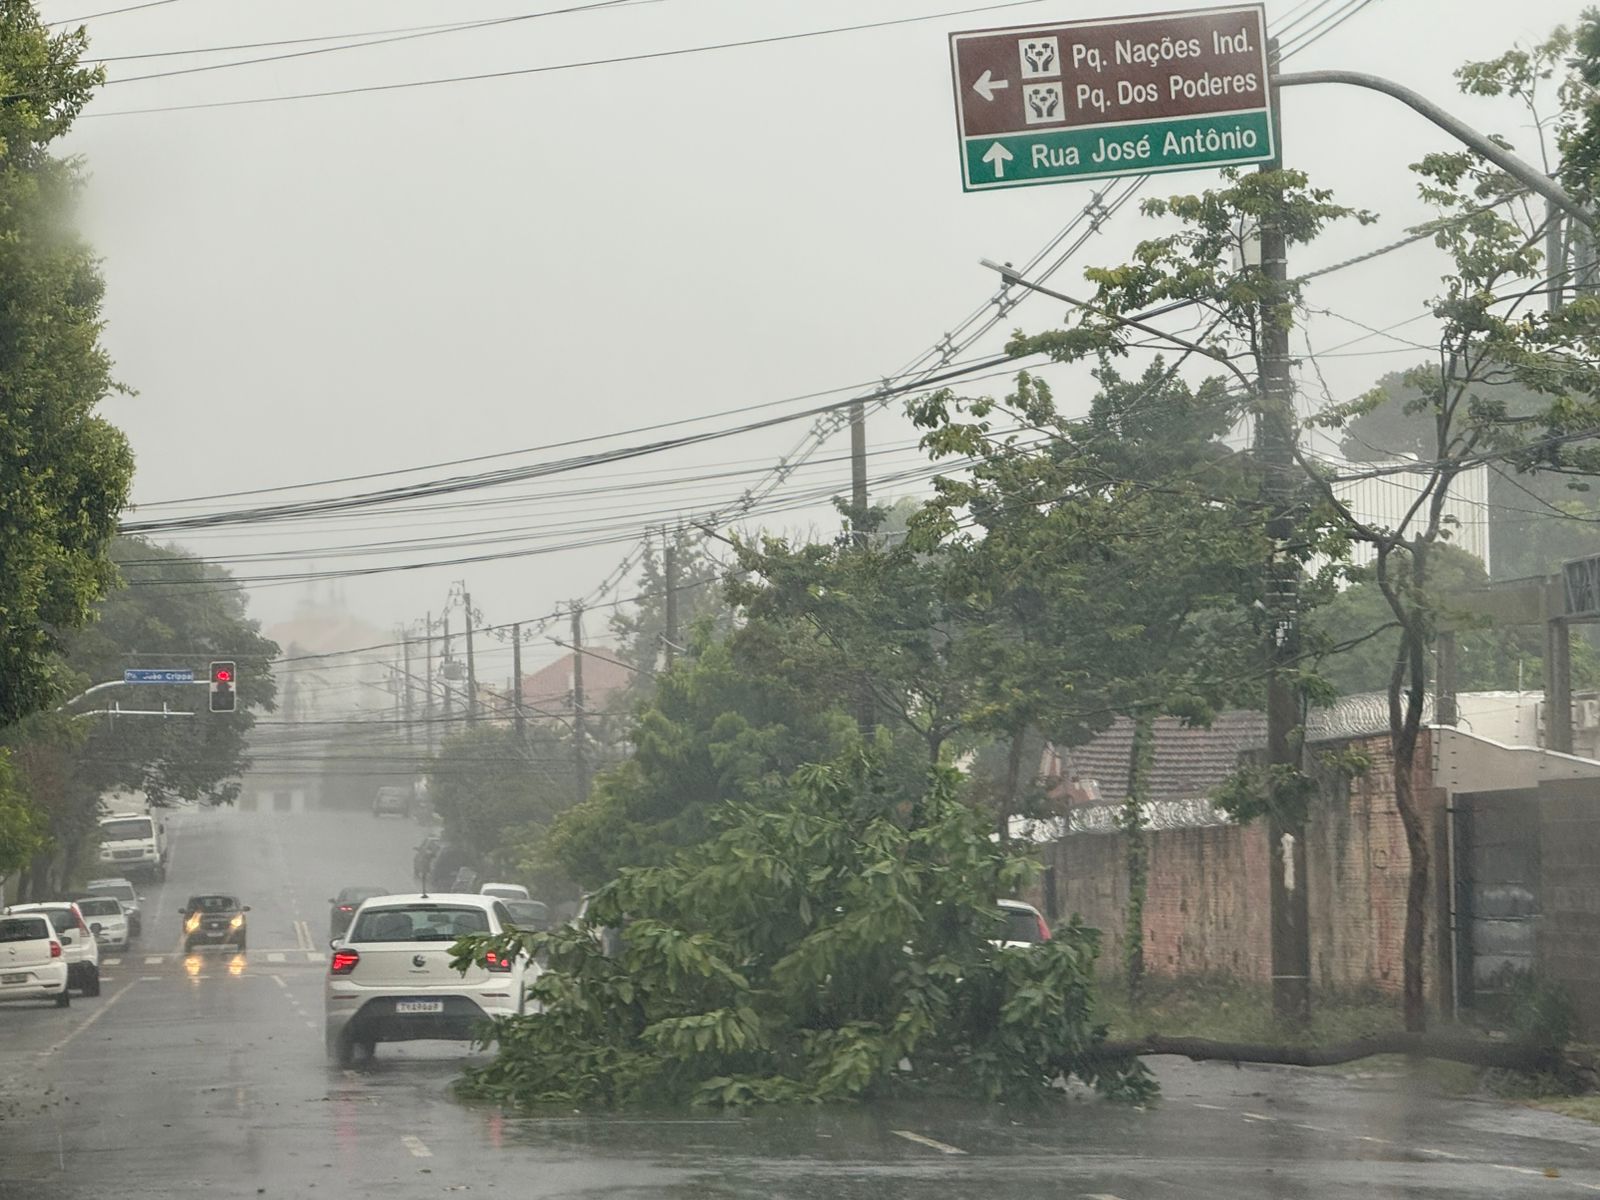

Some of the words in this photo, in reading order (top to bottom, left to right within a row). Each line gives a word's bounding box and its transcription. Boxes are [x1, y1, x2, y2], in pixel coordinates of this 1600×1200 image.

[1072, 44, 1107, 73] Pq.
[1115, 37, 1200, 67] Nações
[1213, 28, 1253, 54] Ind.
[1076, 84, 1111, 113] Pq.
[1118, 80, 1158, 105] Dos
[1170, 72, 1257, 99] Poderes
[1032, 143, 1080, 168] Rua
[1092, 135, 1151, 162] José
[1163, 126, 1257, 156] Antônio
